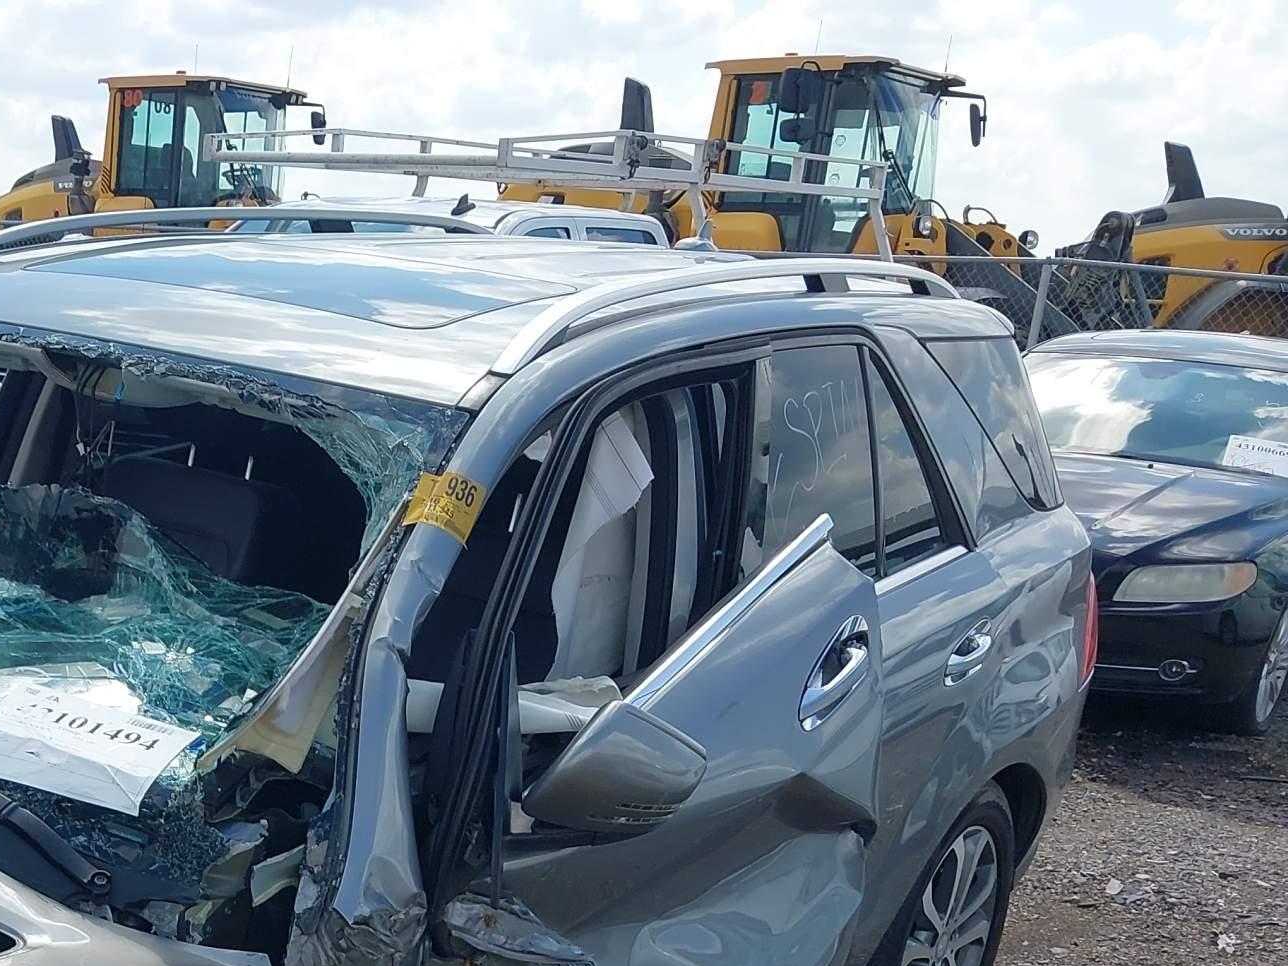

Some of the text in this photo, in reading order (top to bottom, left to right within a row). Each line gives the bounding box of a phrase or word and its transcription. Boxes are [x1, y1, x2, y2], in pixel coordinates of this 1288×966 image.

[1224, 228, 1287, 236] VOLVO
[445, 476, 478, 508] 936
[16, 703, 161, 751] 101494
